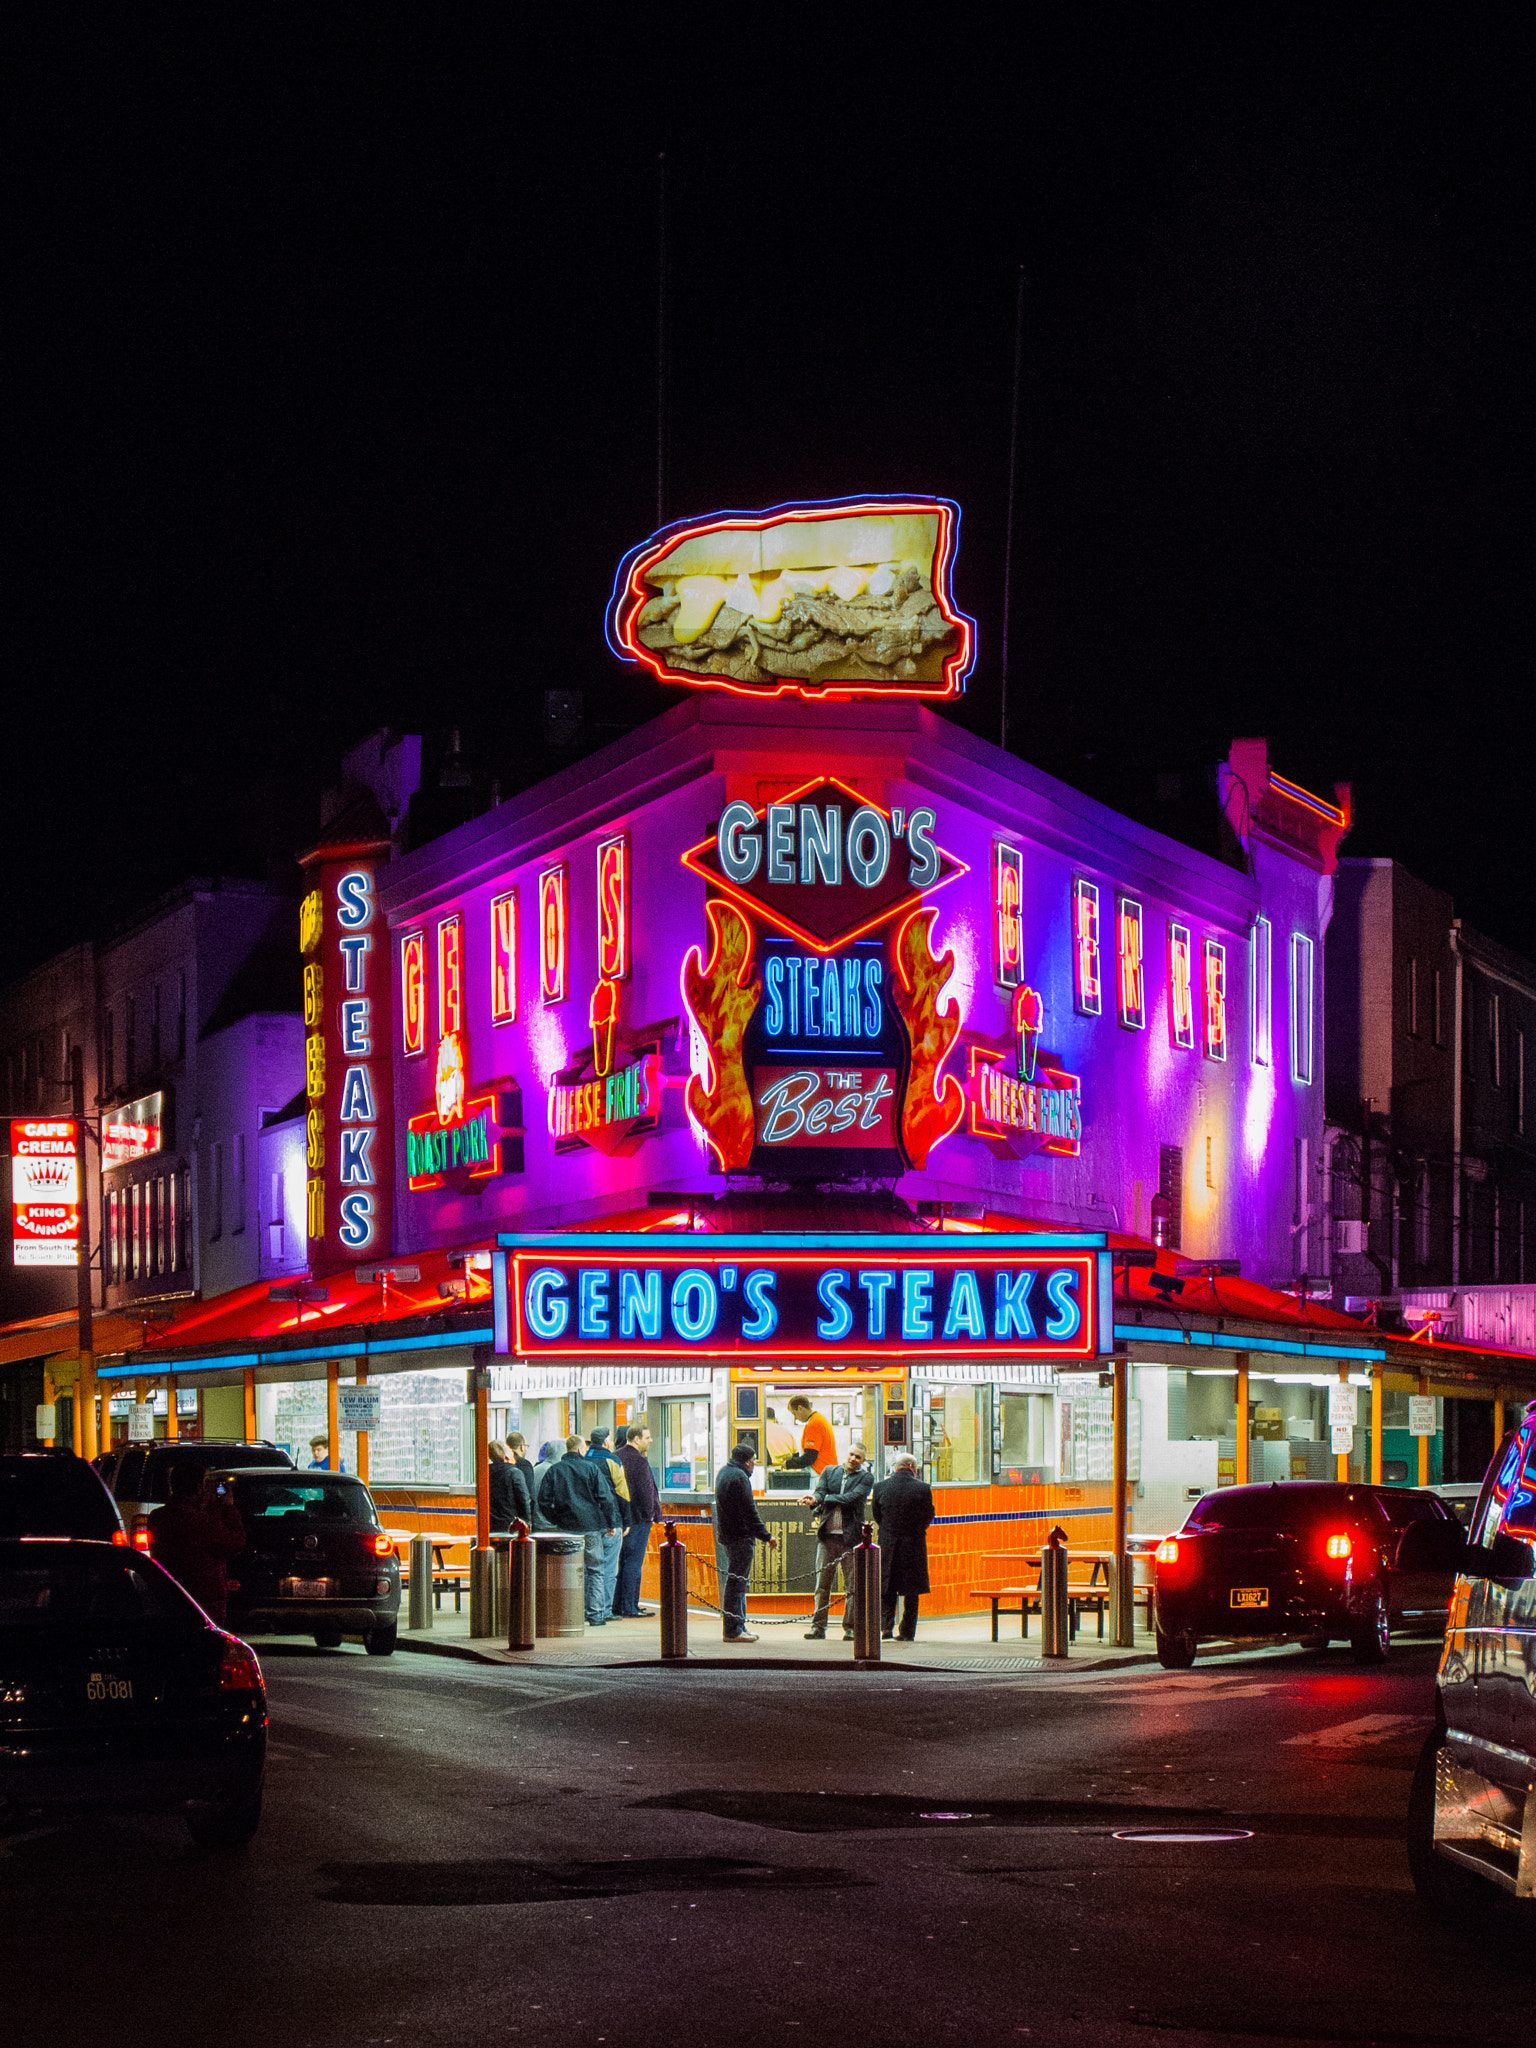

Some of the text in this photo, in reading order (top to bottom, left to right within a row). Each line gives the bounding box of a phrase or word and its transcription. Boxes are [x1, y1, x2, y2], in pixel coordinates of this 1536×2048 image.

[716, 800, 941, 889] GENO'S
[764, 956, 884, 1038] STEAKS
[336, 873, 374, 1246] STEAKS
[825, 1071, 863, 1090] THE
[24, 1123, 68, 1137] CAFE
[304, 965, 326, 1239] BEST
[547, 1055, 650, 1138] CHEESE FRIES
[760, 1071, 894, 1143] Best
[980, 1063, 1082, 1141] CHEESE FRIES
[17, 1141, 76, 1154] CREMA
[407, 1112, 489, 1178] ROAST PORK
[16, 1214, 78, 1236] CANNOLI
[28, 1207, 66, 1218] KING
[524, 1265, 1083, 1341] GENO'S STEAKS
[339, 1396, 379, 1404] LEW BLUM
